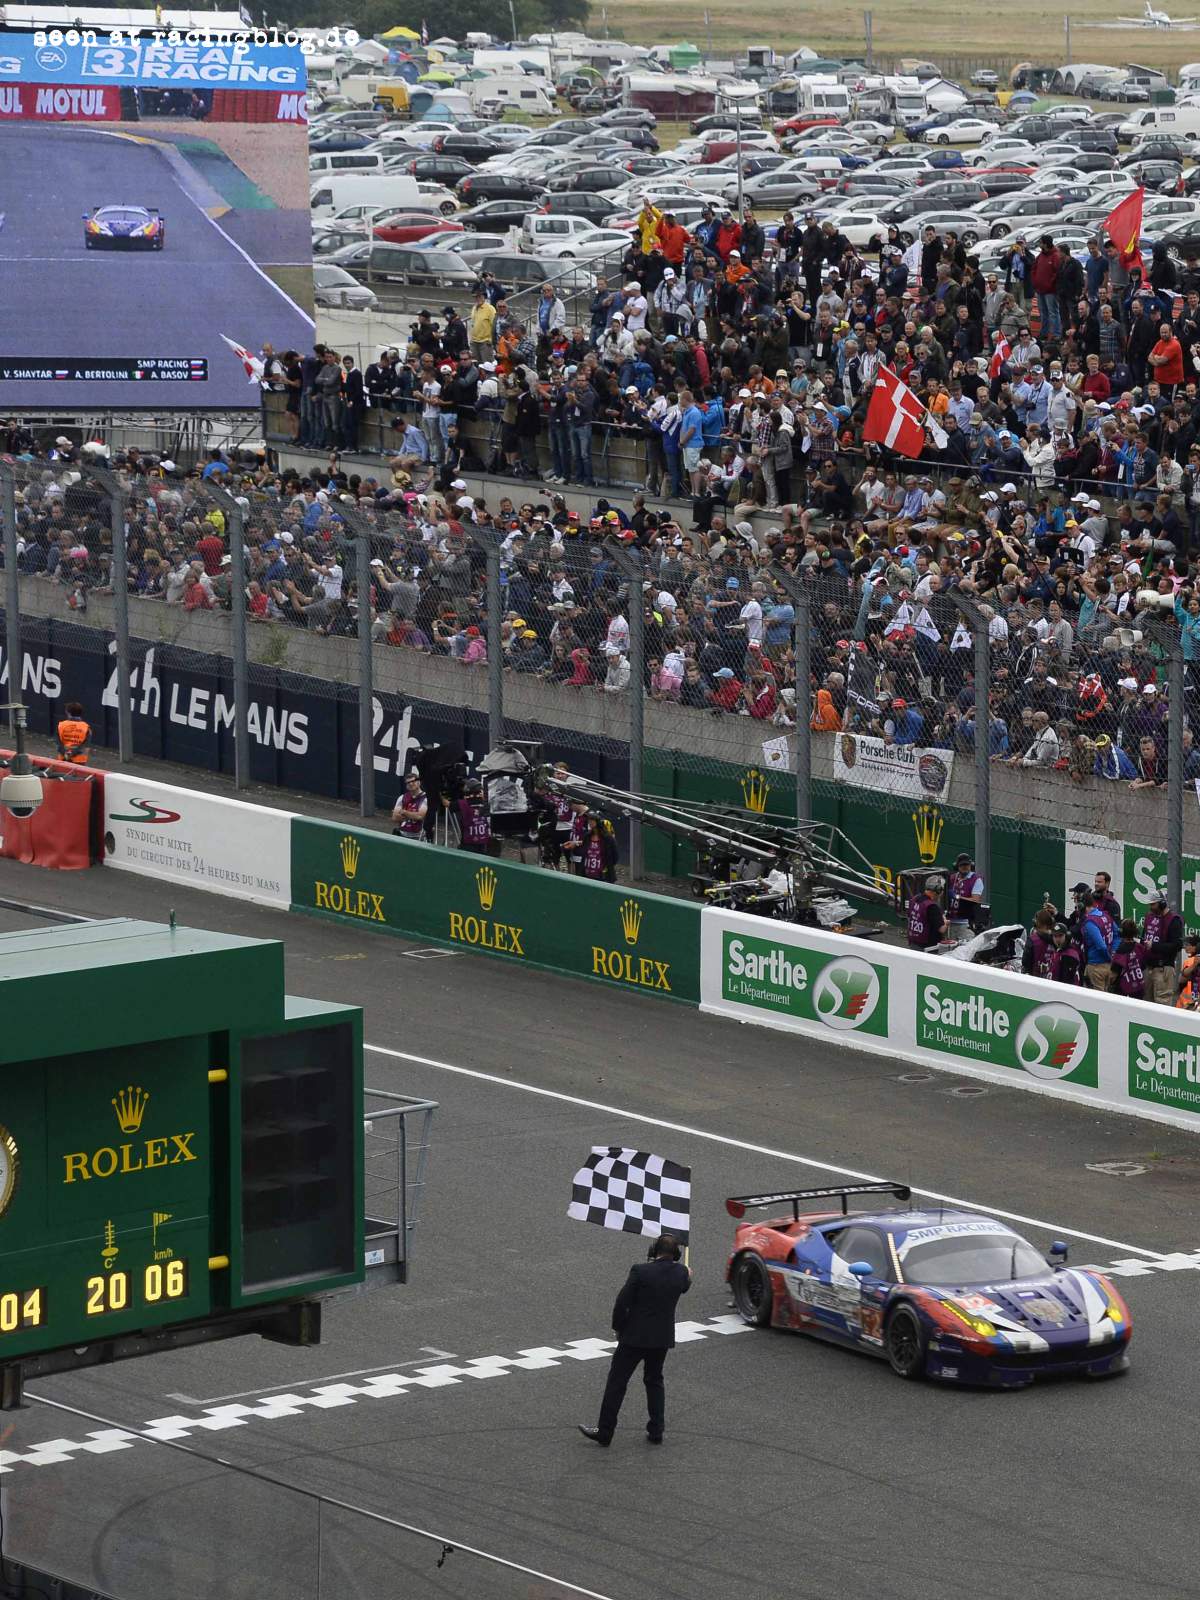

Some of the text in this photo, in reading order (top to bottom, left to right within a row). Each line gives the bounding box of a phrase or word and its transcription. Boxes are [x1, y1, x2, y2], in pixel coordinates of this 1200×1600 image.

[144, 45, 254, 65] REAL
[142, 61, 297, 83] RACING
[36, 88, 107, 116] MOTUL
[3, 370, 53, 379] V. SHAYTAR
[75, 370, 128, 379] A. BERTOLINI
[137, 360, 189, 369] SMP RACING
[151, 370, 189, 379] A. BASOV
[170, 683, 210, 730] LE
[214, 694, 309, 755] MANS
[860, 740, 894, 760] Porsche
[126, 828, 193, 853] SYNDICAT MIXTE
[127, 846, 280, 892] DU CIRCUIT DES 24 HEURES DU MANS
[315, 881, 386, 922] ROLEX
[449, 912, 525, 955] ROLEX
[910, 920, 923, 933] 120
[592, 946, 672, 991] ROLEX
[728, 939, 808, 990] Sarthe
[1124, 967, 1143, 983] 118
[728, 978, 790, 1006] Le Département
[923, 984, 1010, 1038] Sarthe
[923, 1024, 991, 1054] Le Département
[1136, 1074, 1148, 1091] Le
[63, 1133, 197, 1183] ROLEX
[908, 1222, 1005, 1241] SMP RACING
[154, 1248, 173, 1261] km/h
[87, 1272, 126, 1314] 20
[145, 1260, 183, 1301] 06
[0, 1288, 40, 1331] 04
